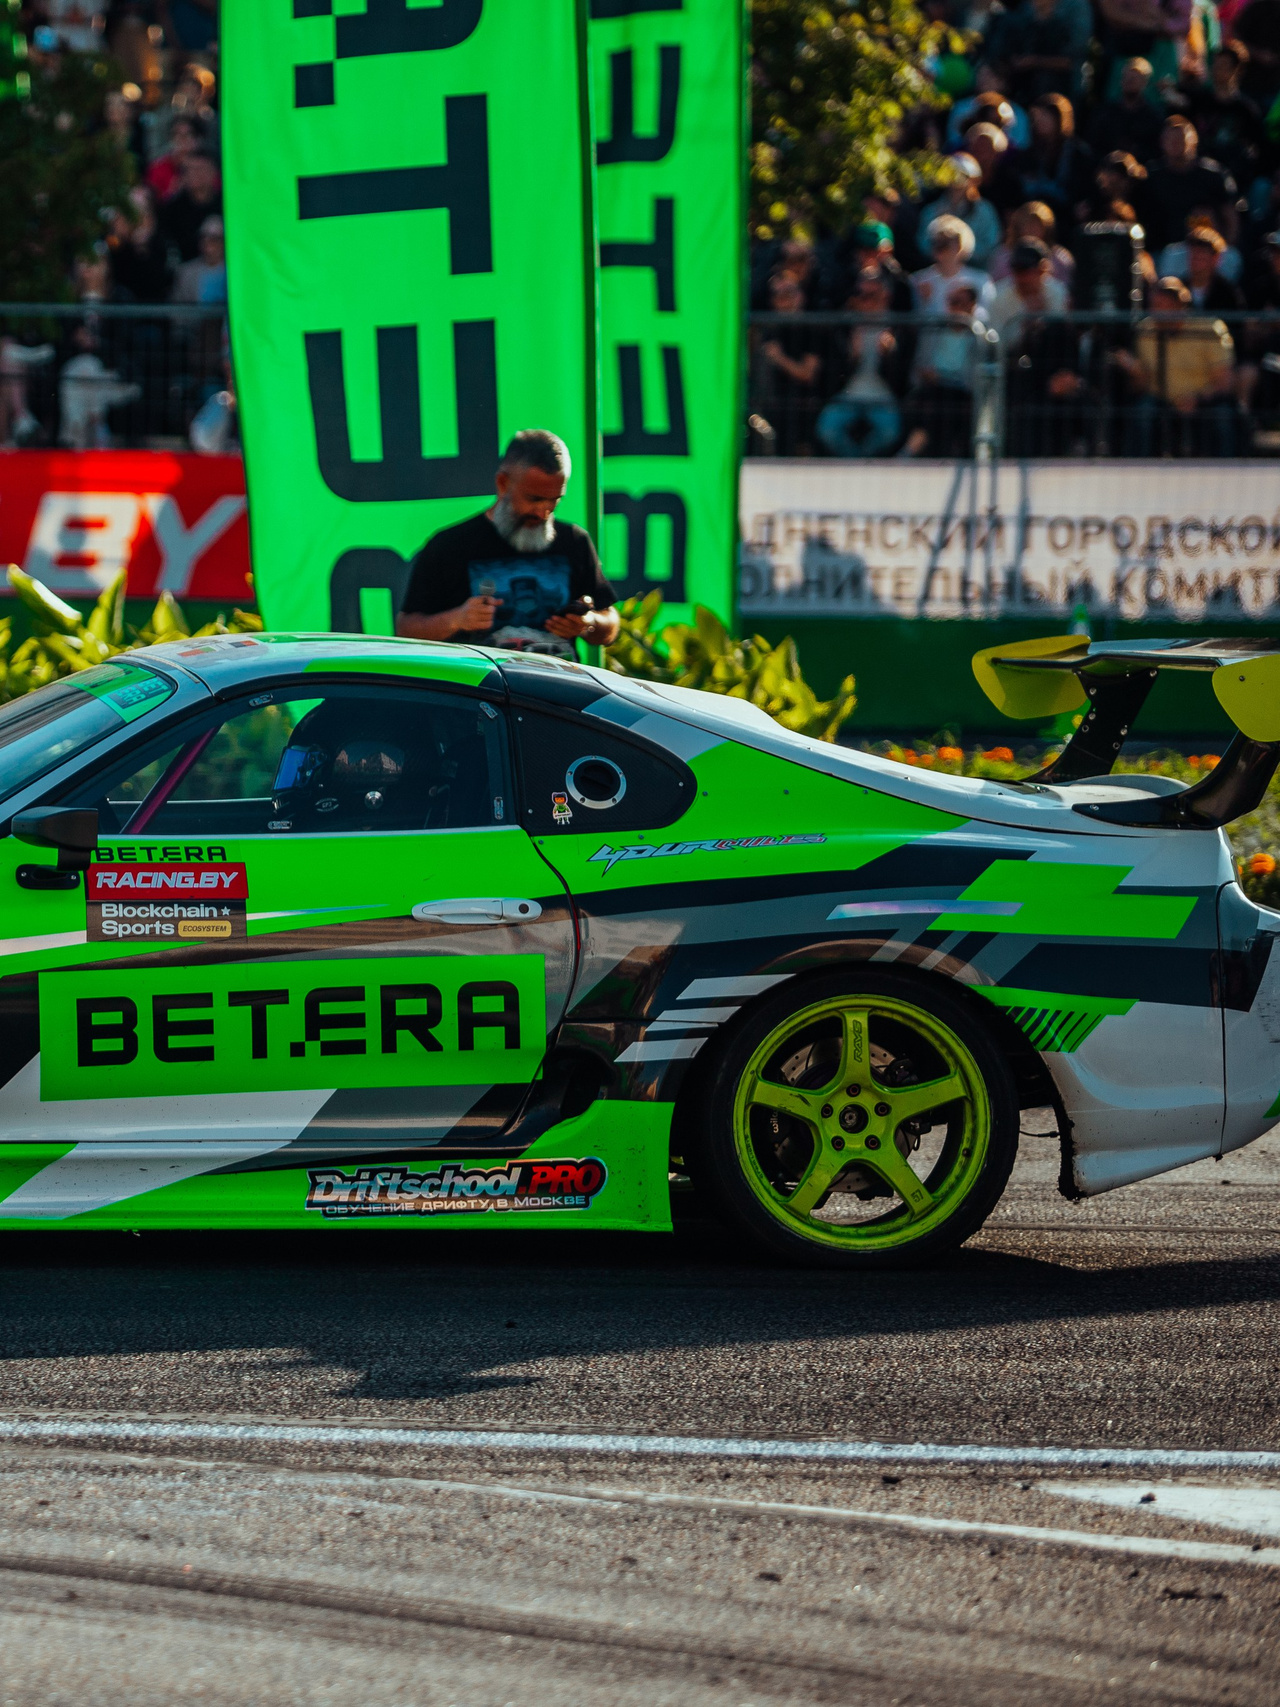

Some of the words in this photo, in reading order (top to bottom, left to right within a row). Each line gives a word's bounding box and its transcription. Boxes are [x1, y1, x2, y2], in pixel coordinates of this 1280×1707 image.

[96, 871, 239, 889] RACING.BY
[101, 903, 218, 918] Blockchain
[101, 920, 175, 937] Sports
[182, 925, 228, 933] ECOSYSTEM
[853, 1019, 863, 1063] RAYS
[326, 1202, 415, 1214] ОБУЧЕНИЕ
[421, 1199, 490, 1212] ДРИФТУ
[497, 1198, 508, 1208] В
[514, 1196, 586, 1207] МОСКВЕ
